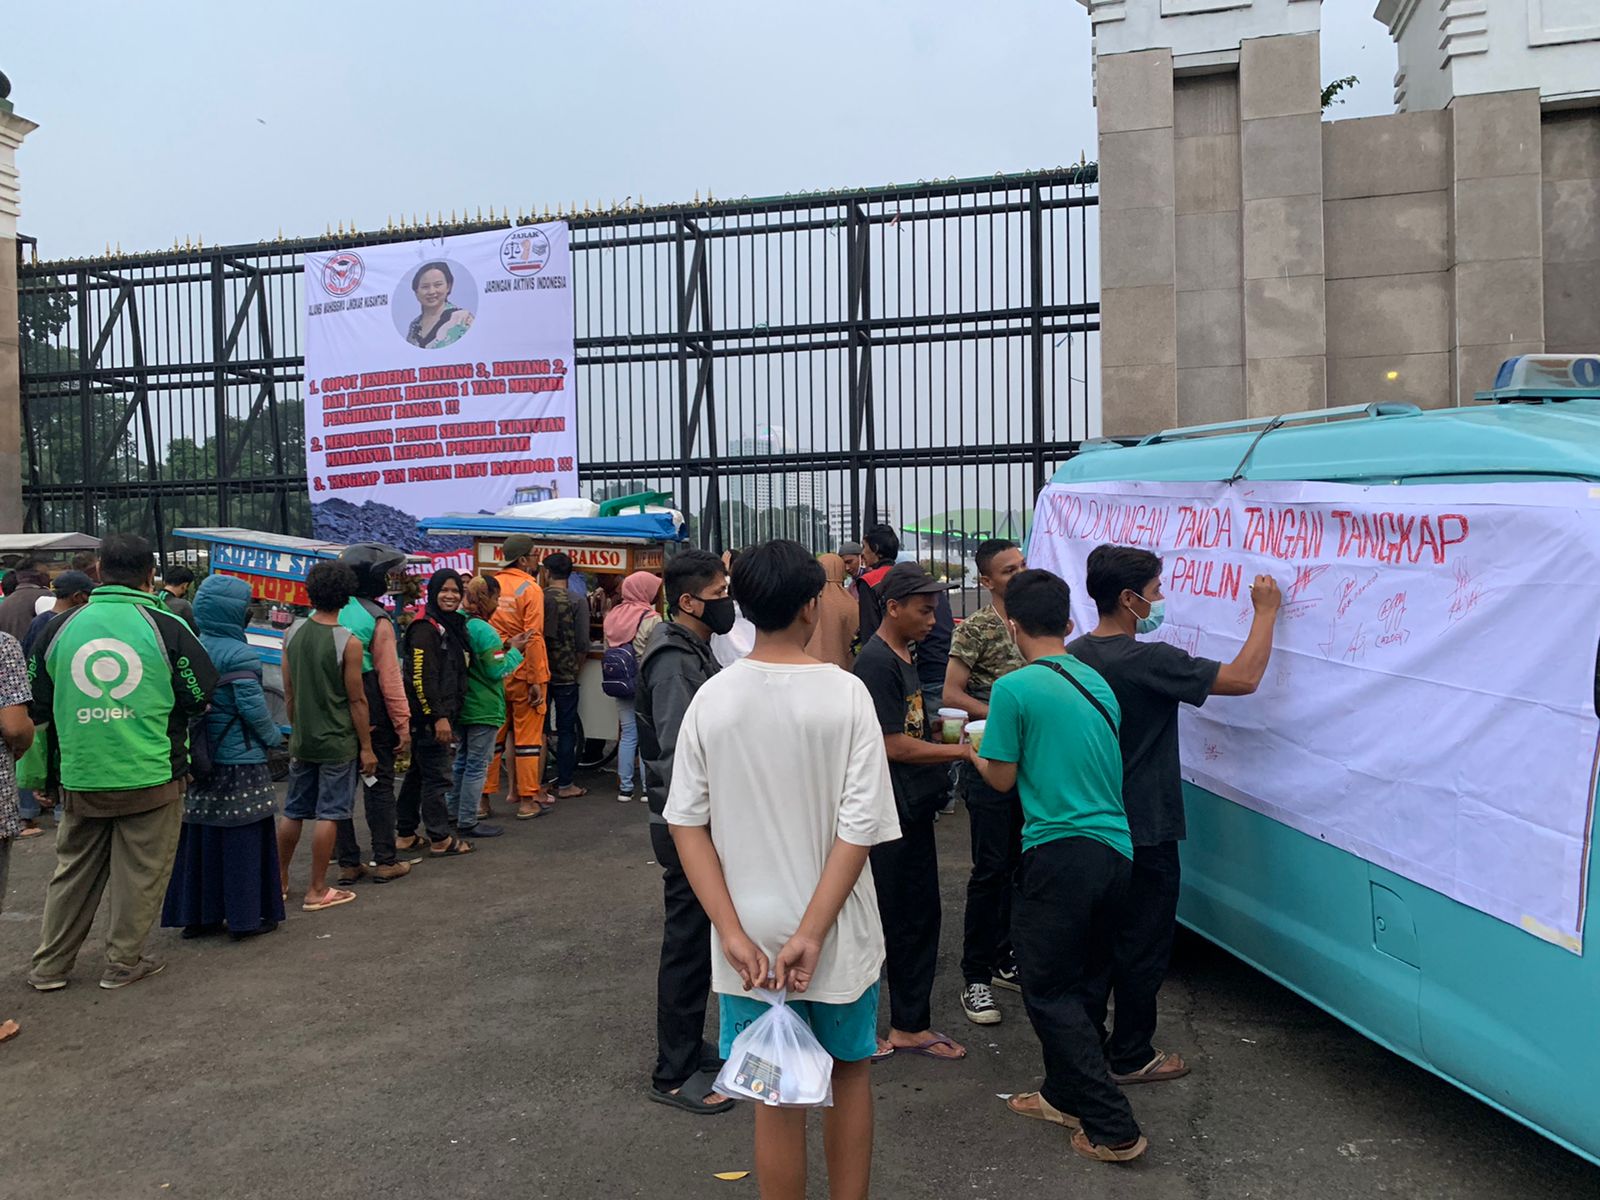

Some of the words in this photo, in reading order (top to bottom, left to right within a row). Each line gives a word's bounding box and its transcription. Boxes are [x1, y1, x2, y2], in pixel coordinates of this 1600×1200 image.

[512, 231, 540, 240] JARAK
[484, 279, 512, 294] JARINGAN
[513, 277, 535, 291] AKTIVIS
[537, 275, 567, 290] INDONESIA
[309, 379, 320, 395] 1.
[321, 374, 359, 393] COPOT
[360, 368, 418, 389] JENDERAL
[419, 363, 474, 382] BINTANG
[475, 362, 491, 379] 3,
[492, 359, 551, 377] BINTANG
[552, 358, 568, 376] 2,
[322, 393, 346, 410] DAN
[347, 387, 404, 408] JENDERAL
[404, 382, 460, 401] BINTANG
[461, 381, 469, 396] 1
[470, 379, 507, 396] YANG
[508, 375, 564, 394] MENJADI
[323, 405, 393, 427] PENGHIANAT
[394, 400, 444, 419] BANGSA
[445, 399, 460, 415] !!!
[310, 436, 323, 452] 2.
[324, 428, 394, 450] MENDUKUNG
[395, 424, 437, 443] PENUH
[439, 420, 497, 439] SELURUH
[498, 416, 566, 435] TUNTUTAN
[325, 446, 392, 467] MAHASISWA
[393, 441, 444, 461] KEPADA
[446, 436, 531, 456] PEMERINTAH
[313, 476, 326, 491] 3.
[327, 470, 381, 489] TANGKAP
[382, 468, 406, 484] TAN
[407, 464, 452, 482] PAULIN
[454, 462, 488, 479] RATU
[490, 457, 556, 476] KORIDOR
[1081, 500, 1170, 548] DUKUNGAN
[1173, 506, 1232, 549] TANDA
[1243, 507, 1324, 560] TANGAN
[1331, 510, 1470, 564] TANGKAP
[215, 543, 279, 571] KUPAT
[568, 550, 620, 566] BAKSO
[1170, 556, 1243, 602] PAULIN
[180, 668, 205, 703] gojek
[77, 703, 136, 724] gojek
